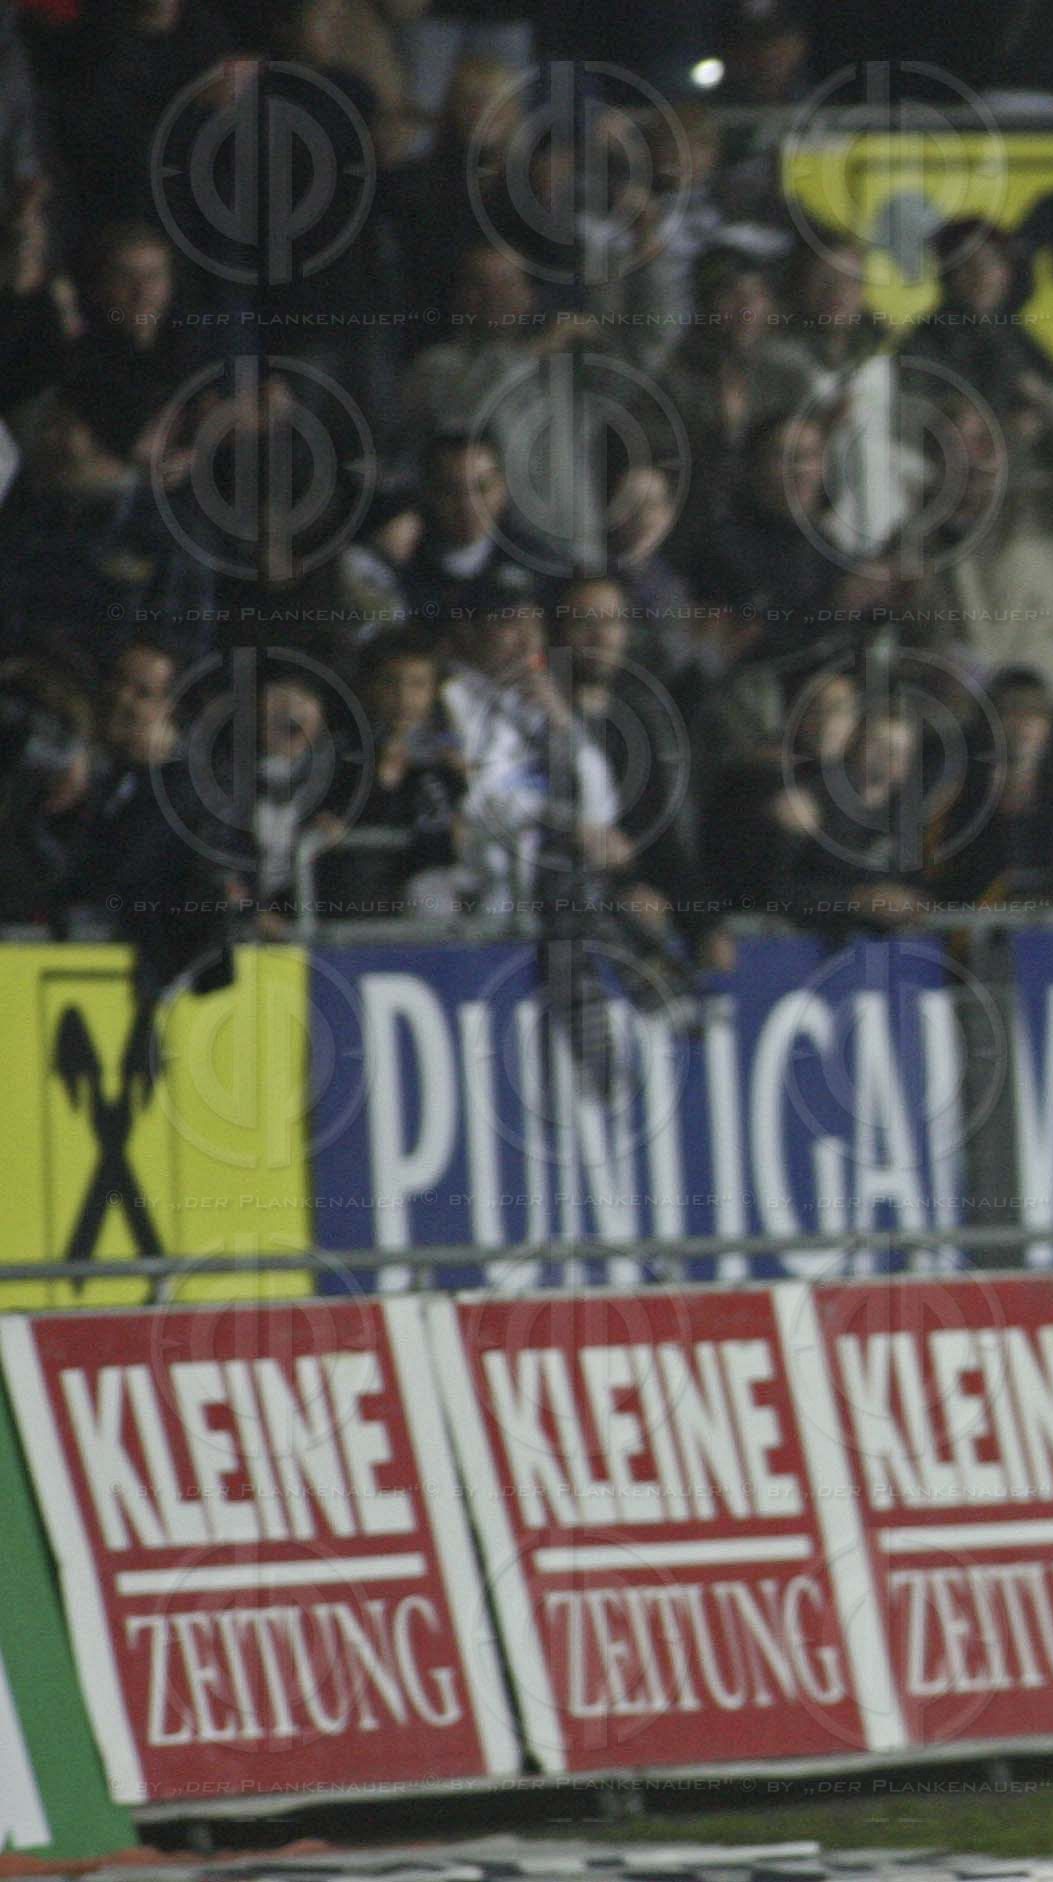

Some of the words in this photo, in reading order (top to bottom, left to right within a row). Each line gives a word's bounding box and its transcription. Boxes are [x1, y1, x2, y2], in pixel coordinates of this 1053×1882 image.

[61, 1352, 415, 1552] KLEINE
[484, 1338, 803, 1528] KLEINE
[127, 1596, 462, 1746] ZEITUNG
[547, 1574, 846, 1719] ZEITUNG
